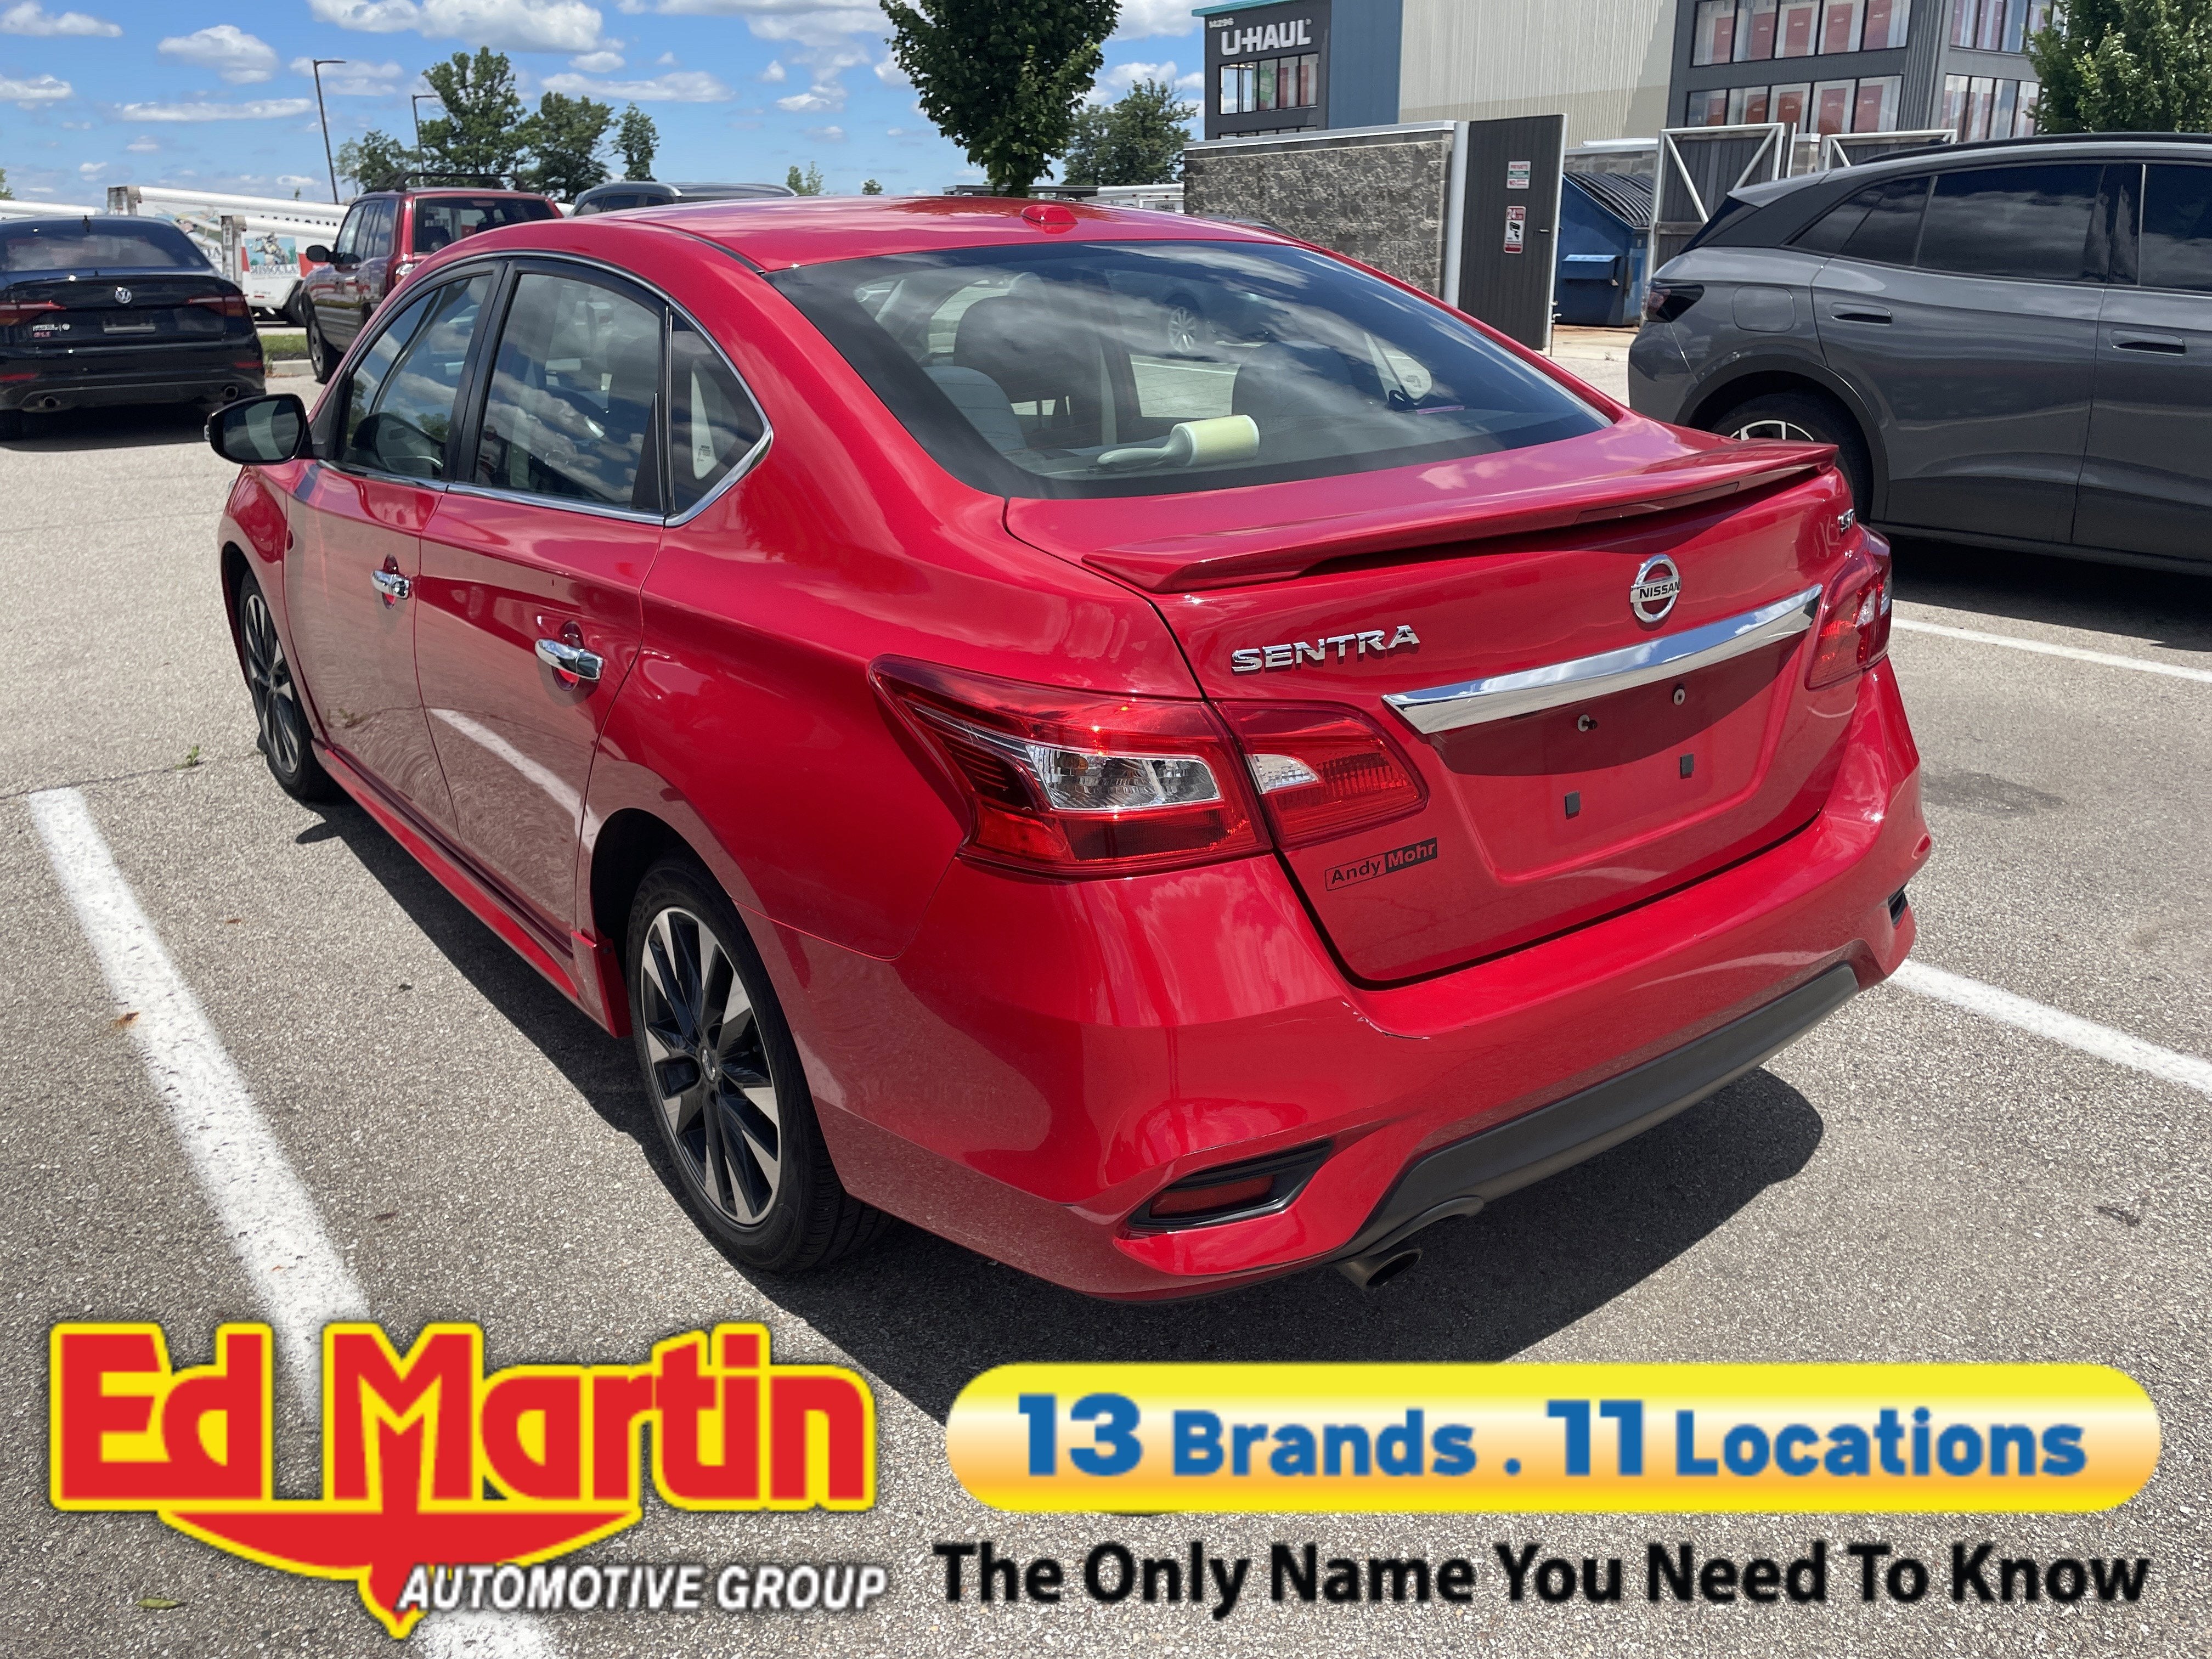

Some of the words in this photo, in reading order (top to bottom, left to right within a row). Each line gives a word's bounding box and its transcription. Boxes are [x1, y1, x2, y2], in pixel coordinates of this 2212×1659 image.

[1221, 19, 1313, 55] U-HAUL
[1639, 577, 1681, 599] NISSAN
[1231, 624, 1420, 672] SENTRA
[1331, 860, 1381, 884] Andy
[1387, 843, 1435, 868] Mohr
